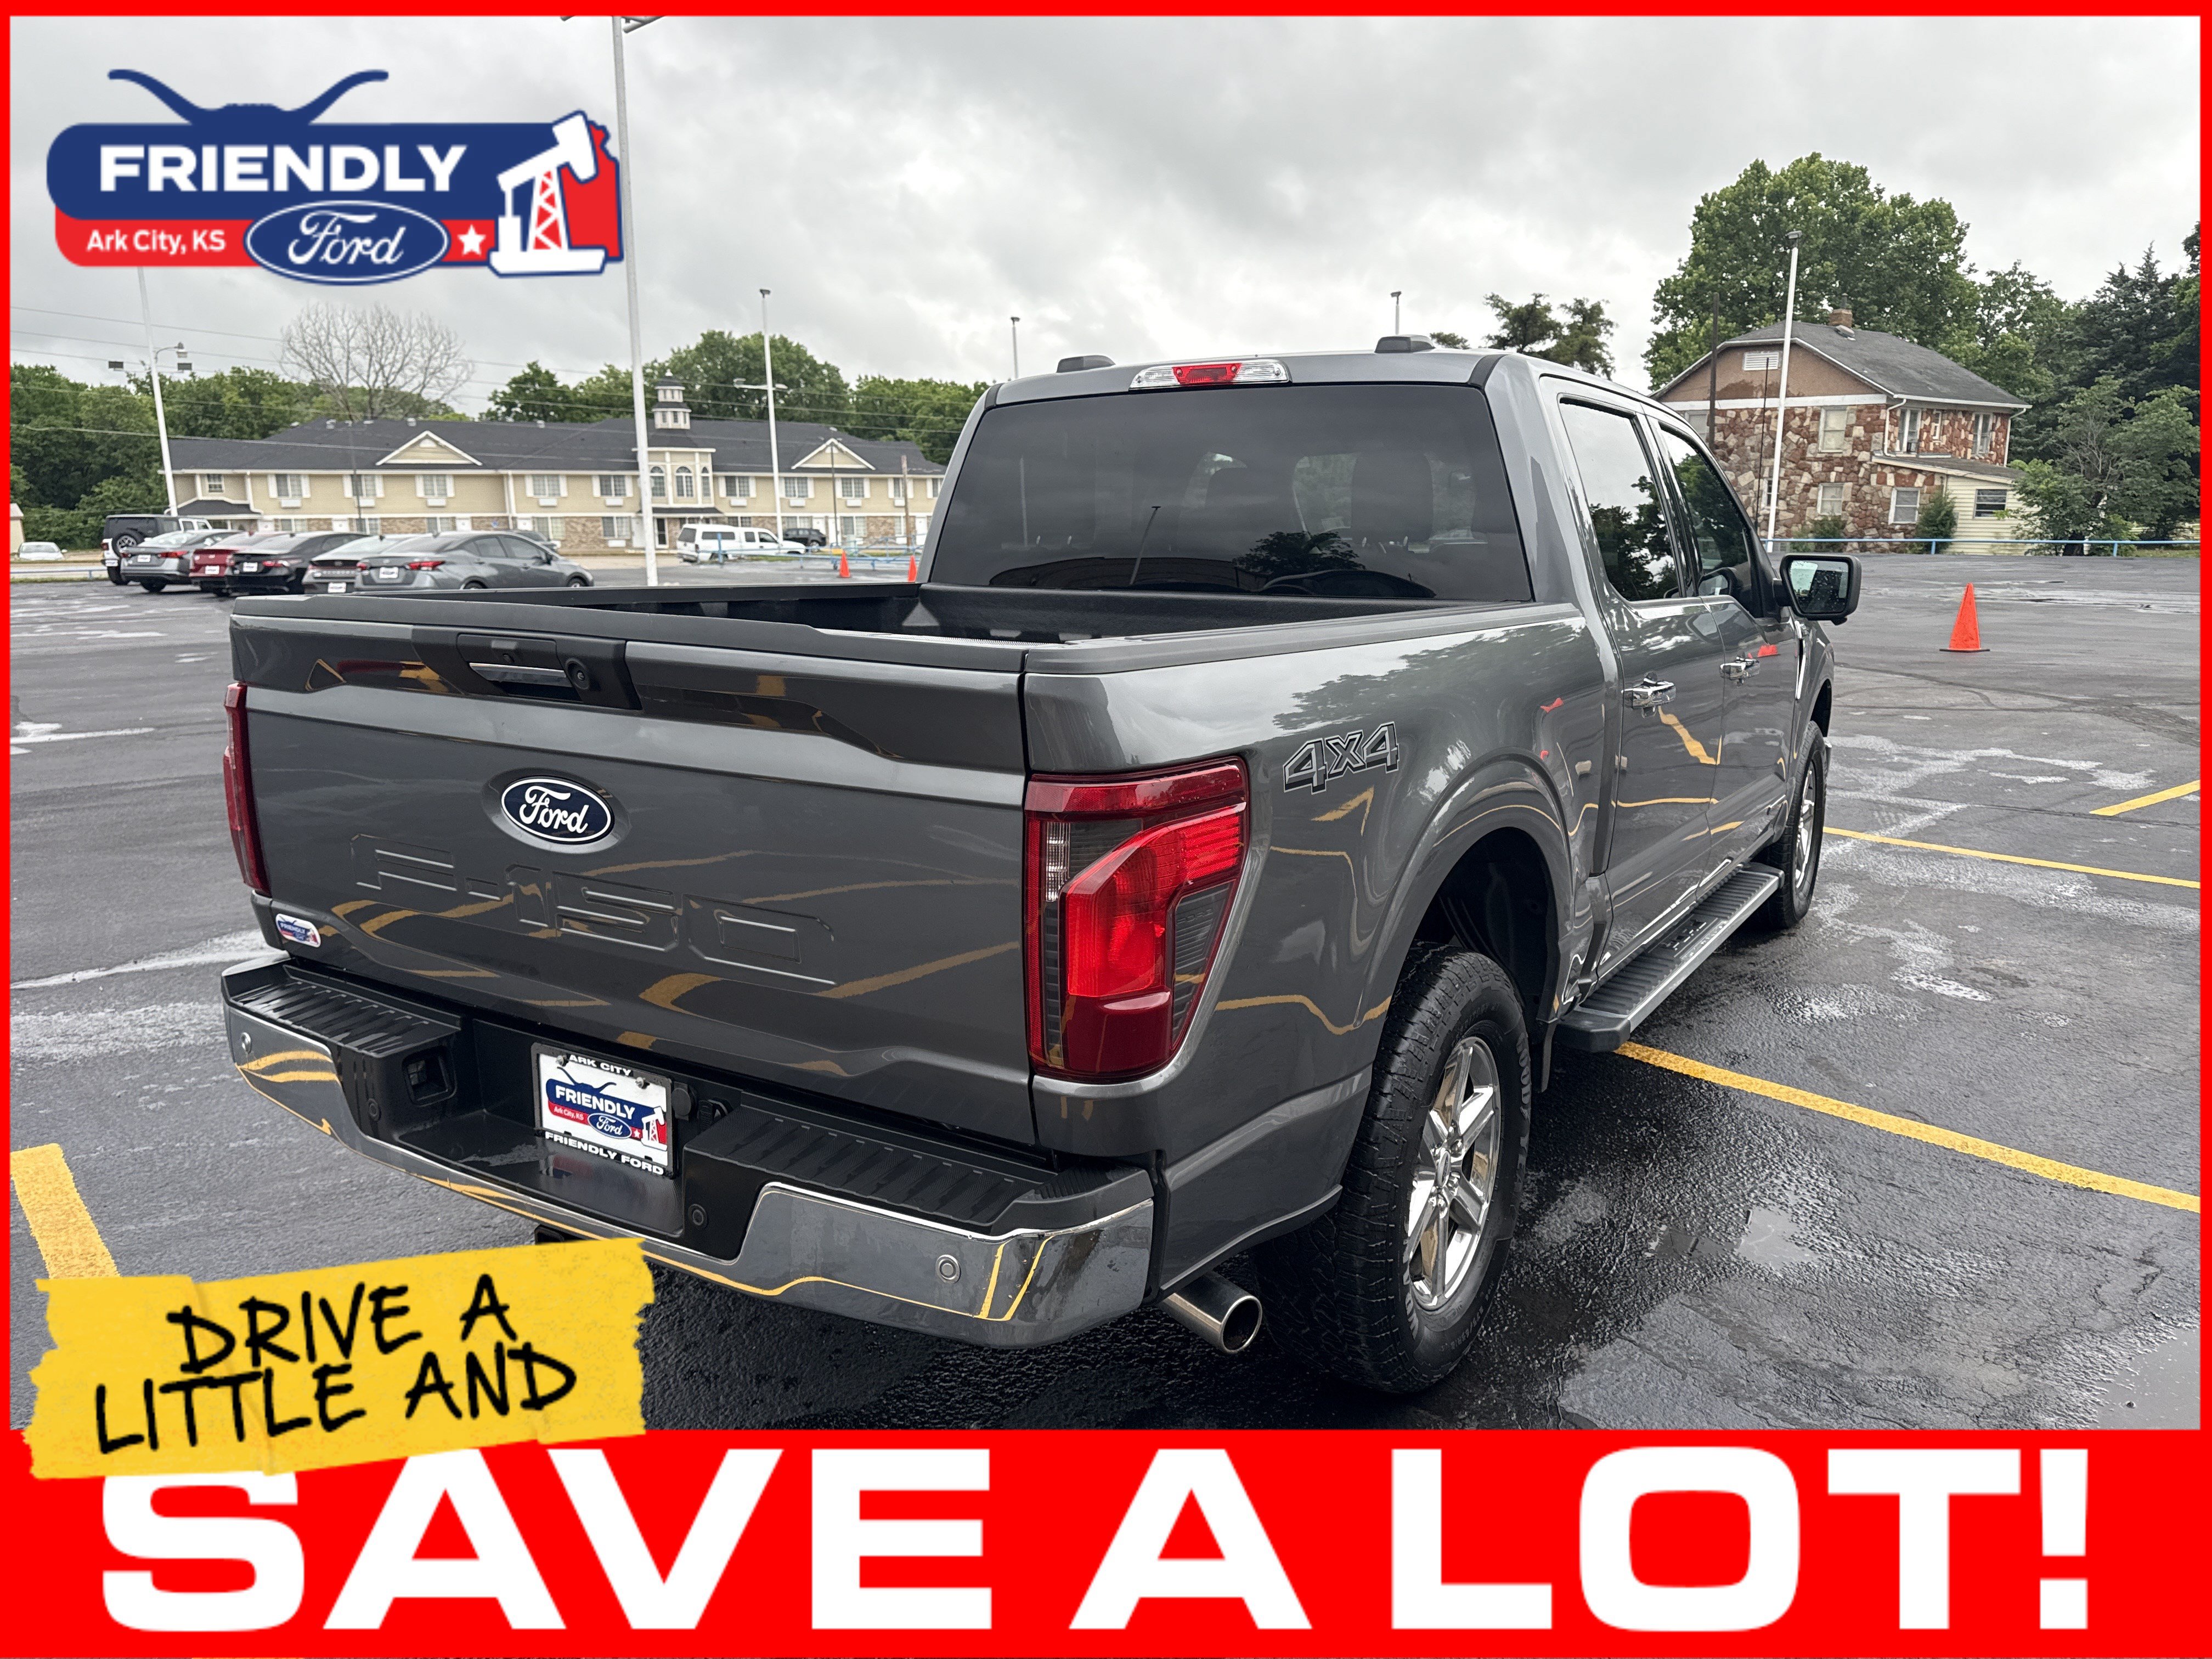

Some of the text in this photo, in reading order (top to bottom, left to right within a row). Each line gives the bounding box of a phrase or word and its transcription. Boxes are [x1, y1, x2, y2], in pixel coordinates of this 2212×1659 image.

[520, 786, 589, 834] Ford
[349, 833, 838, 985] F-150
[569, 1054, 631, 1076] ARK CITY
[556, 1085, 635, 1120] FRIENDLY
[596, 1115, 623, 1136] Ford
[545, 1131, 664, 1176] FRIENDLY FORD
